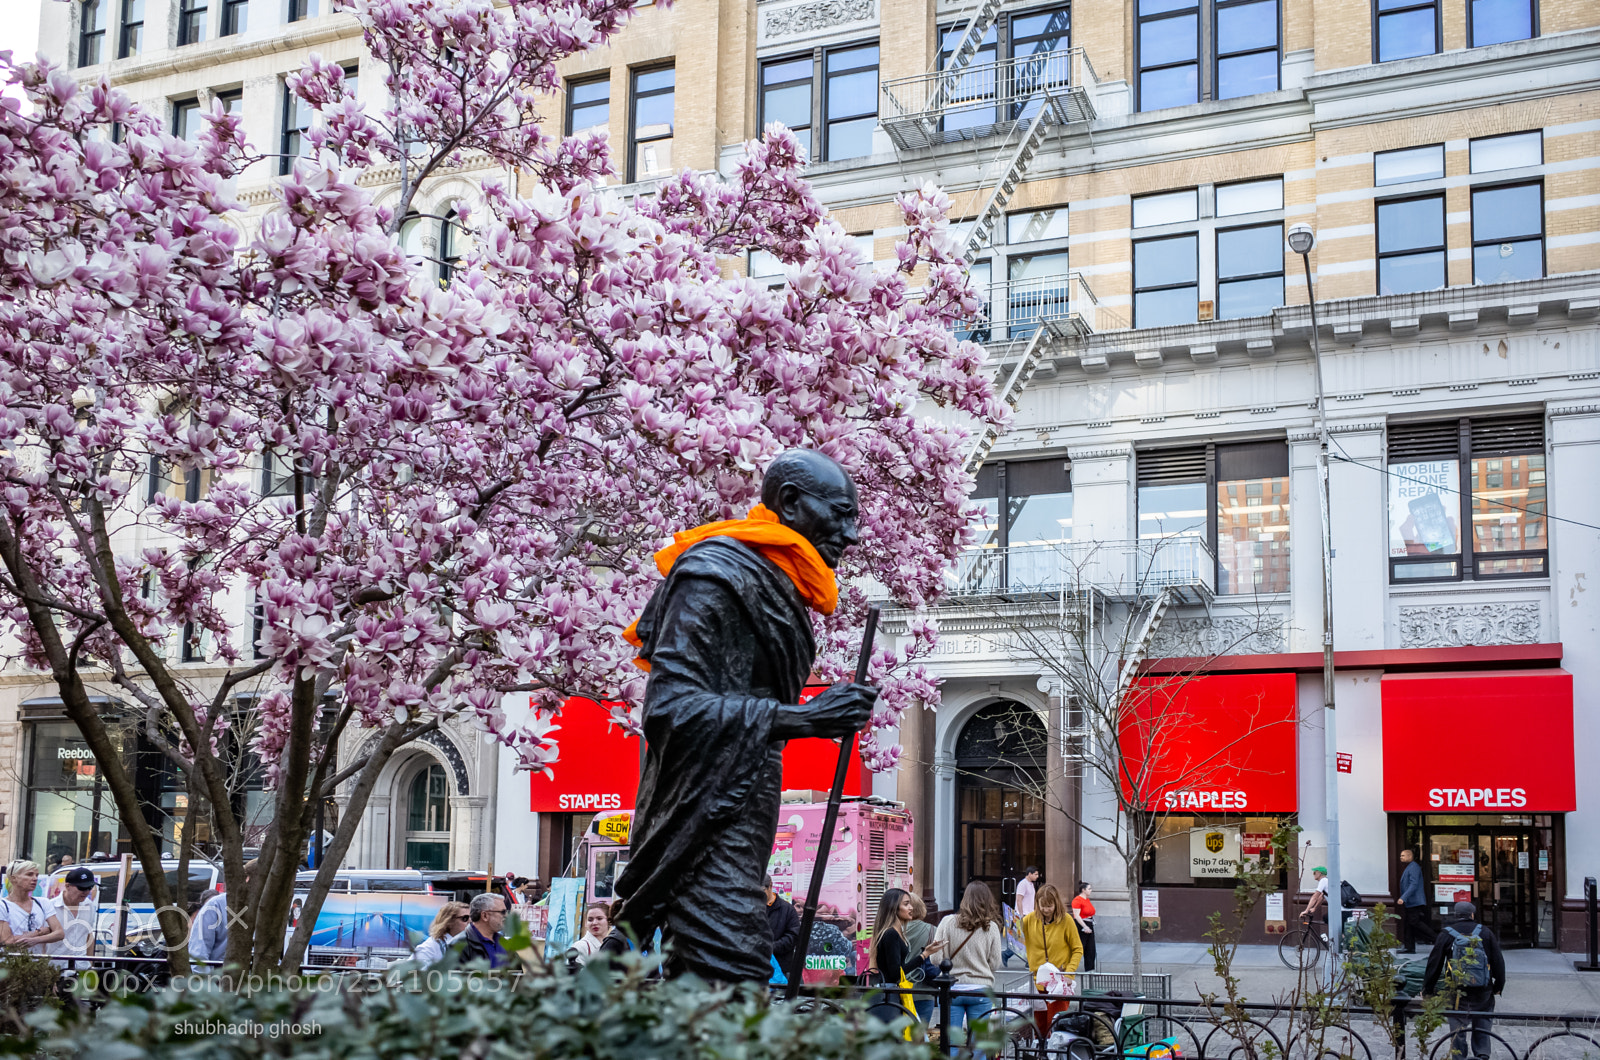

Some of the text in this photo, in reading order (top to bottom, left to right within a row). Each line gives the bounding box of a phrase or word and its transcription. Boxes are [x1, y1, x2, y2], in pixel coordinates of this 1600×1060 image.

[1396, 462, 1449, 475] MOBILE
[1399, 473, 1448, 486] PHONE
[1398, 484, 1449, 498] REPAIR
[57, 747, 96, 759] Reebok
[559, 793, 621, 809] STAPLES
[1164, 791, 1248, 808] STAPLES
[1428, 788, 1527, 807] STAPLES
[605, 822, 629, 833] SLOW
[1207, 838, 1223, 851] ups
[1193, 858, 1211, 867] Ship
[1208, 866, 1231, 874] week.
[805, 954, 847, 970] SHAKES
